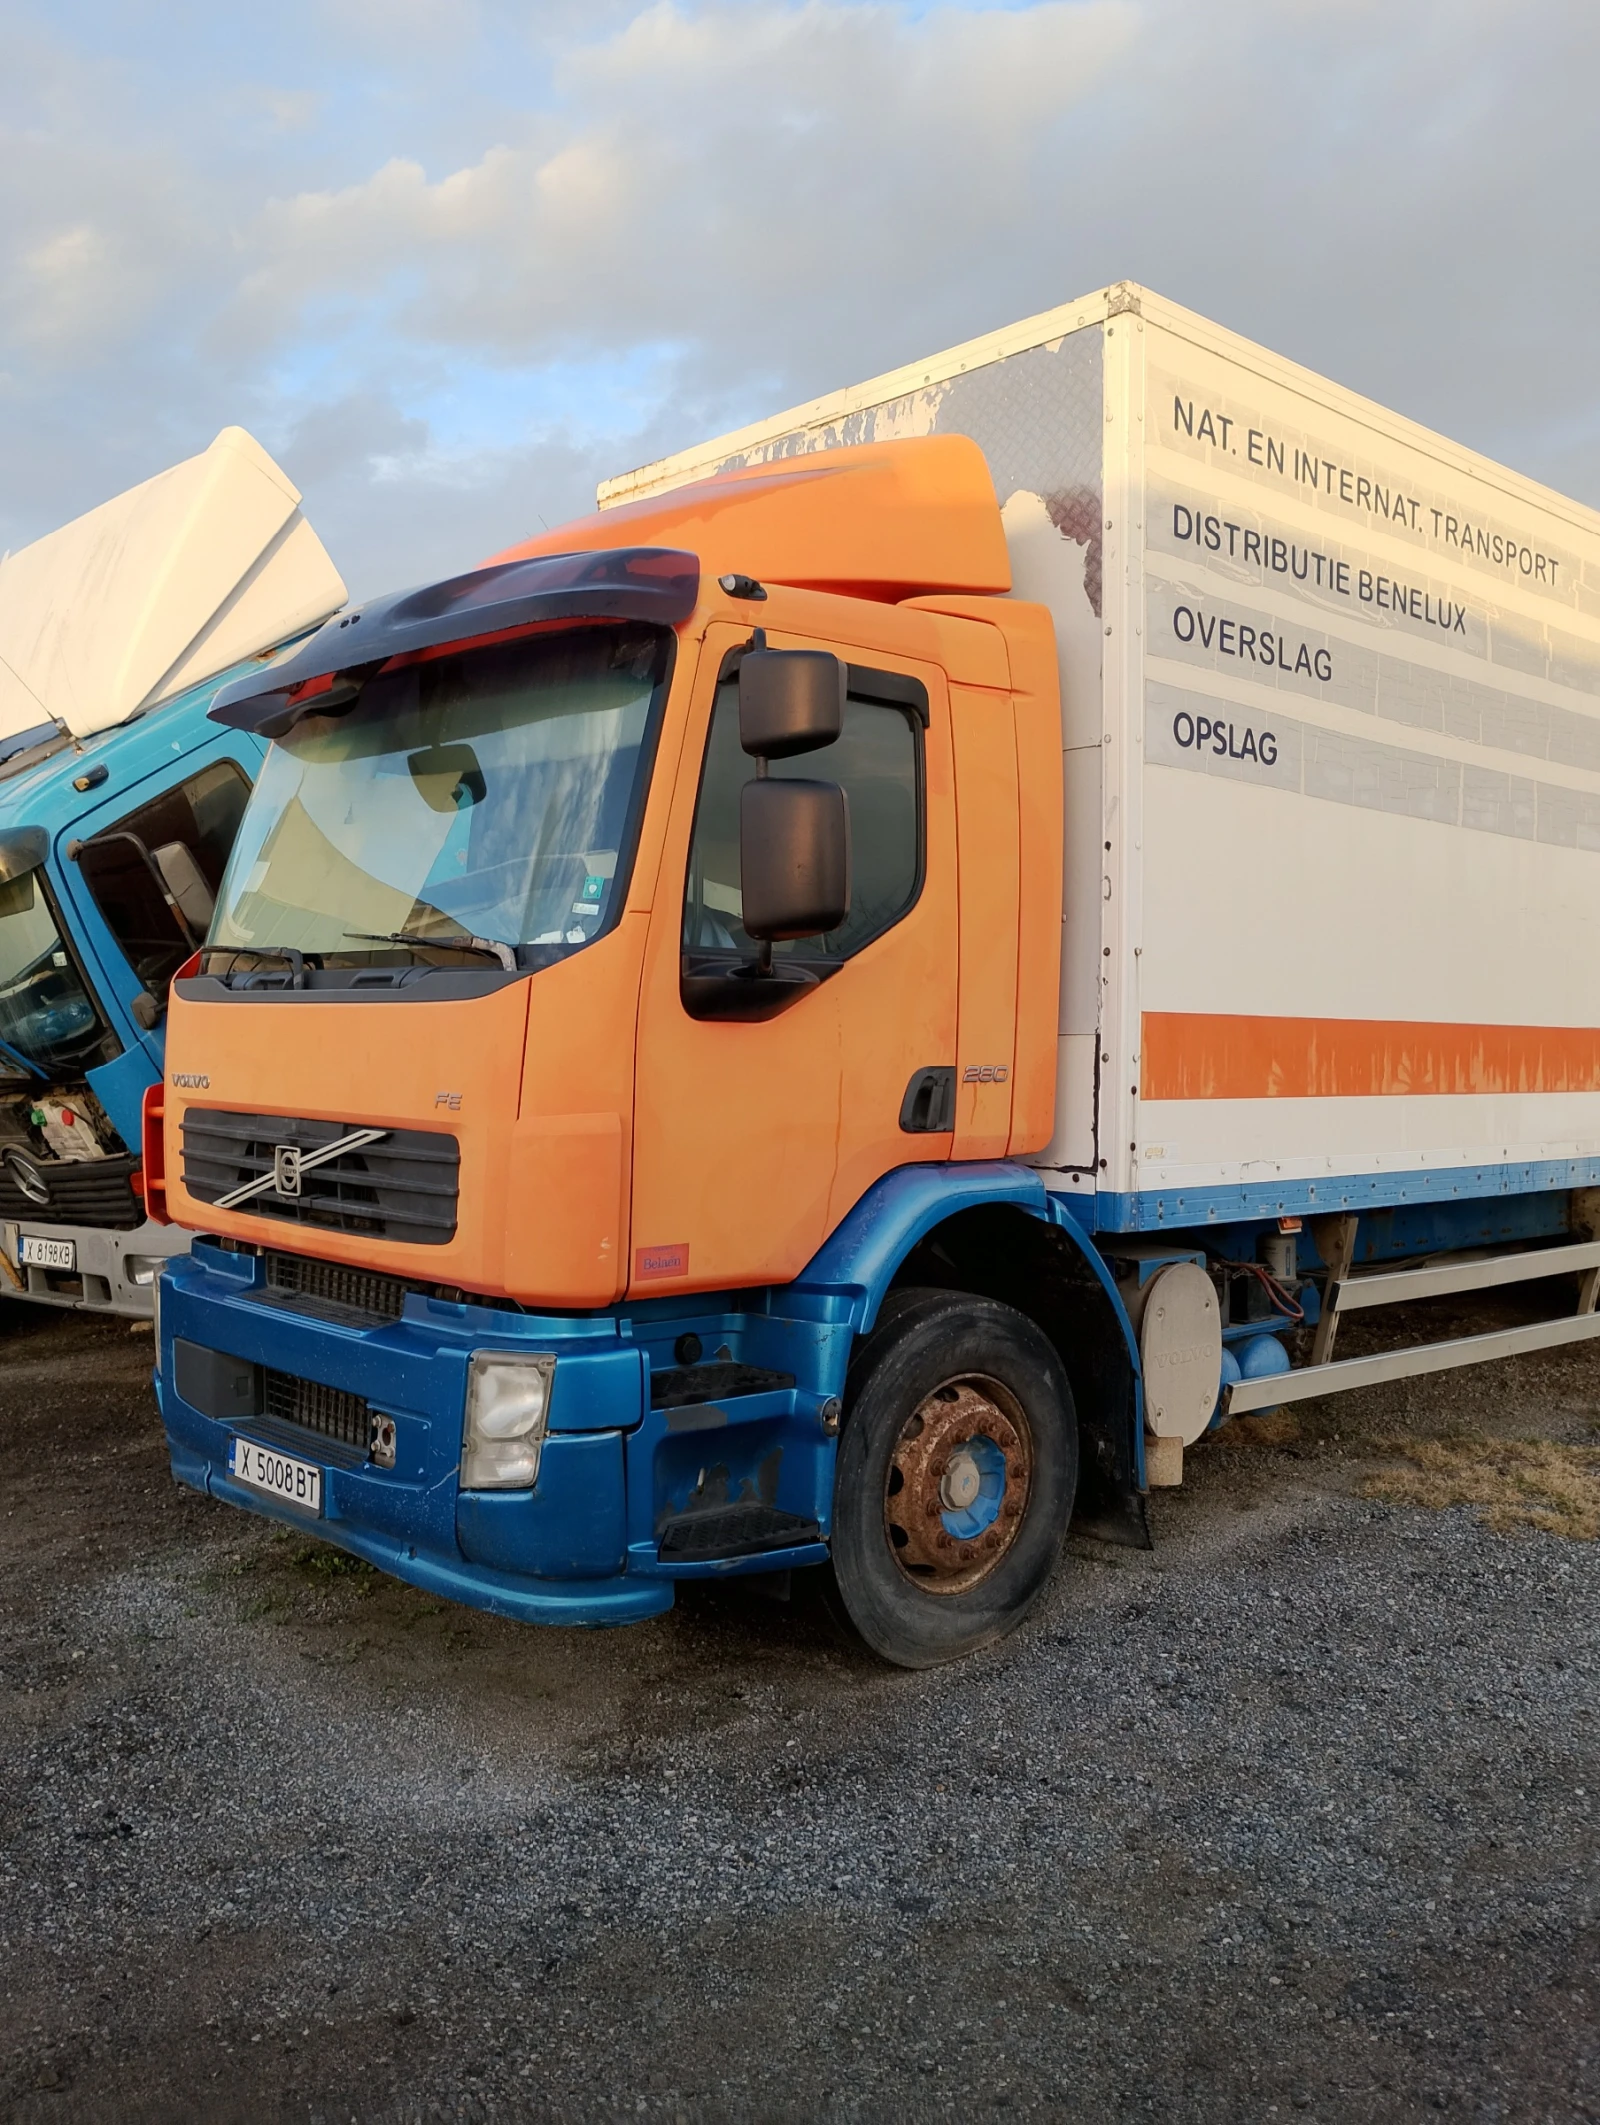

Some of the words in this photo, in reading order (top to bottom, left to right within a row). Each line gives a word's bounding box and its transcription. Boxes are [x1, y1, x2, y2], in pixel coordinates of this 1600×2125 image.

[1174, 395, 1237, 456] NAT.
[1248, 428, 1285, 475] EN
[1294, 448, 1423, 533] INTERNAT.
[1430, 508, 1559, 586] TRANSPORT
[1173, 503, 1351, 596] DISTRIBUTIE
[1359, 569, 1466, 635] BENELUX
[1173, 606, 1332, 681] OVERSLAG
[1173, 711, 1278, 765] OPSLAG
[171, 1073, 210, 1089] VOLVO
[963, 1065, 1008, 1082] 280
[435, 1092, 463, 1111] FE
[1154, 1344, 1215, 1369] VOLVO
[241, 1445, 251, 1477] X
